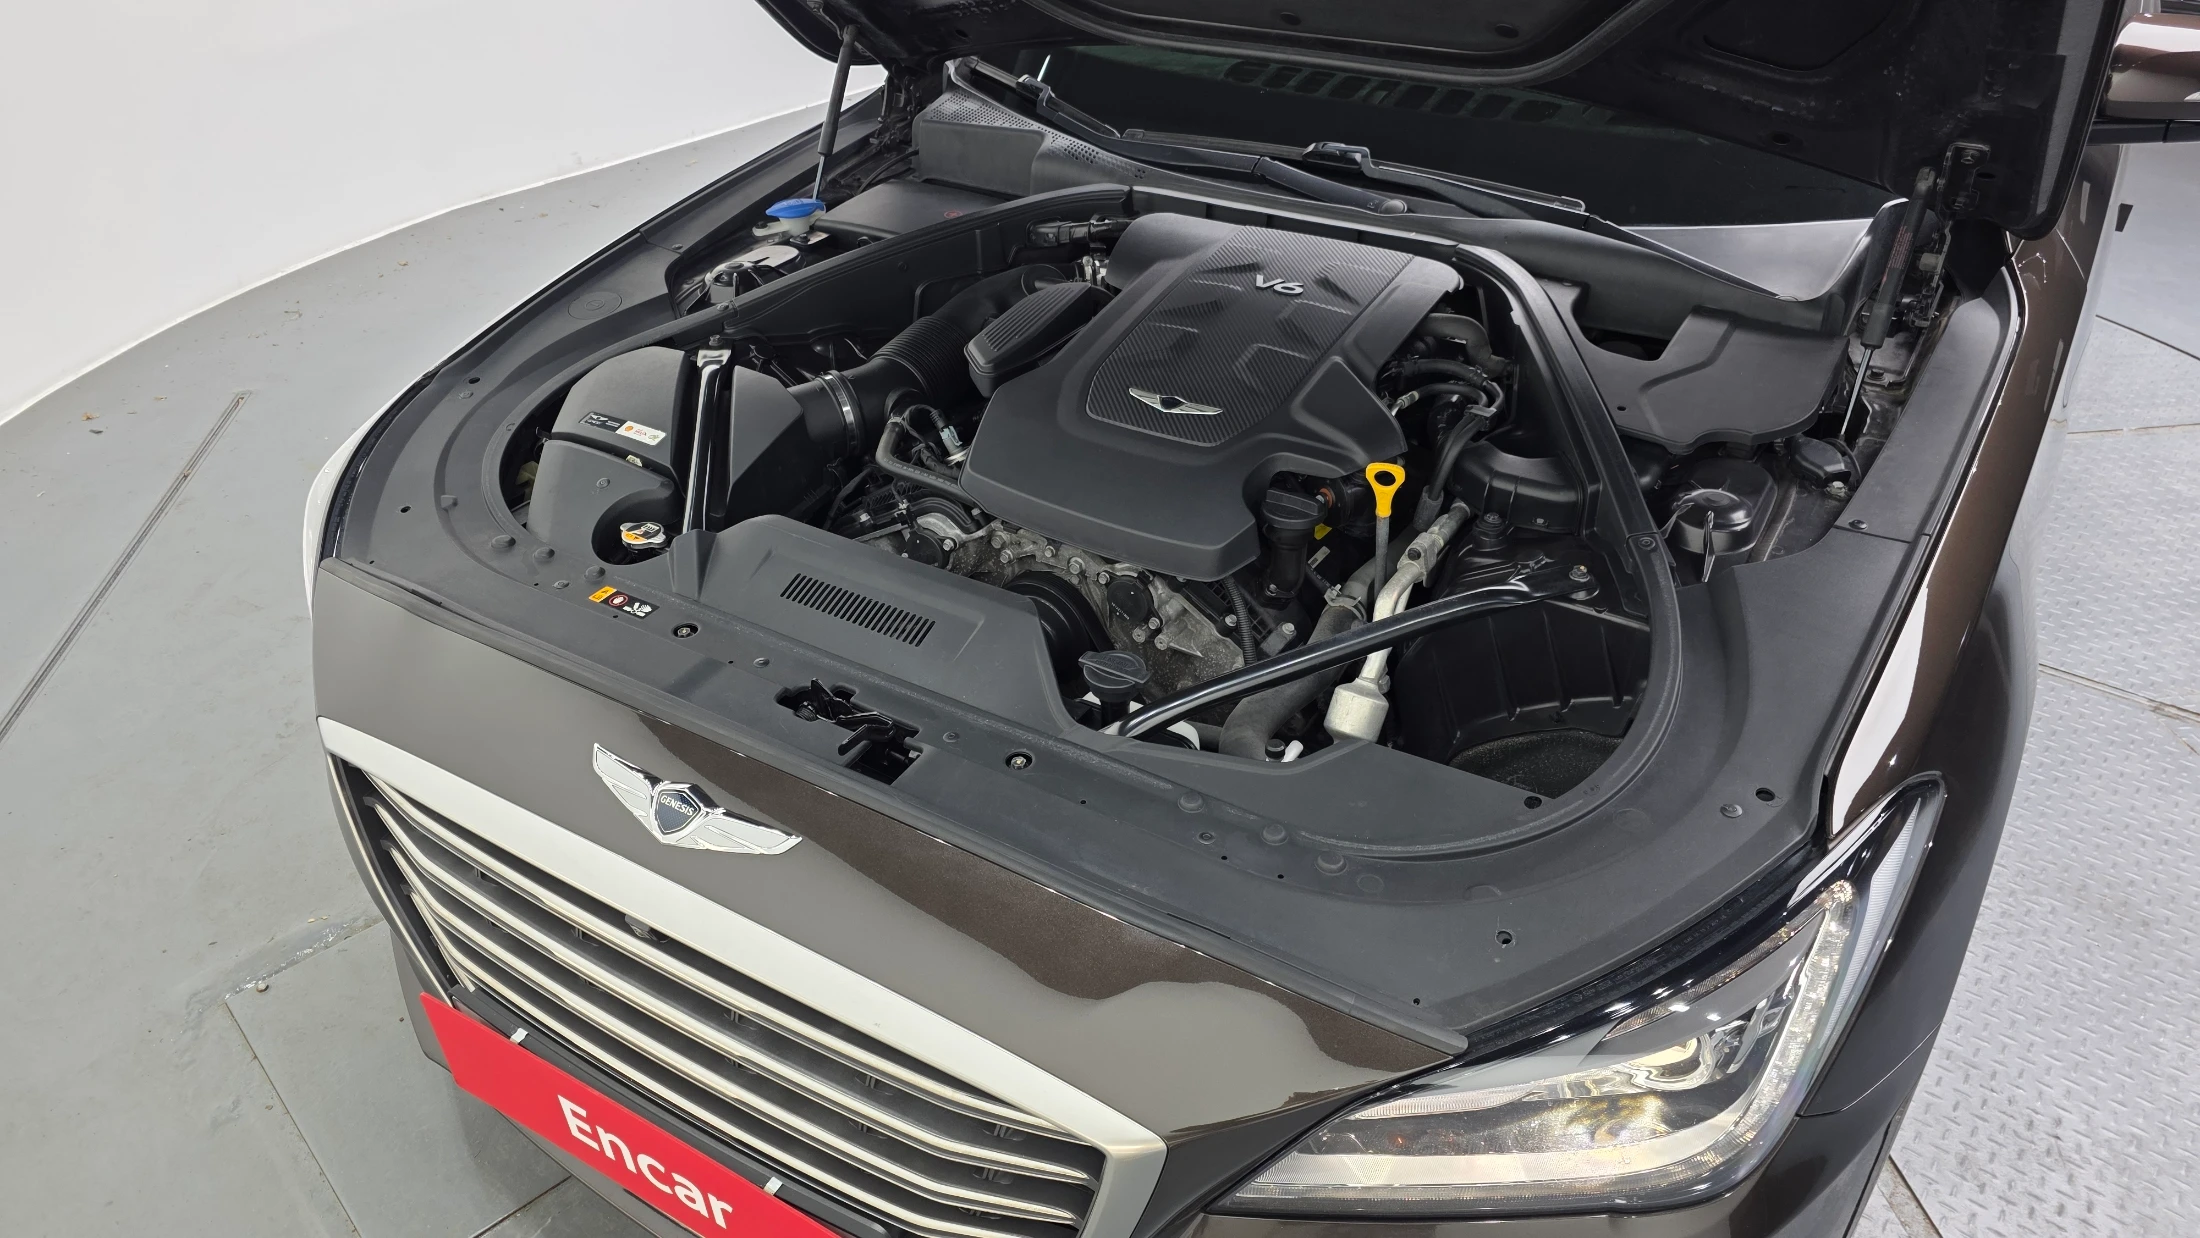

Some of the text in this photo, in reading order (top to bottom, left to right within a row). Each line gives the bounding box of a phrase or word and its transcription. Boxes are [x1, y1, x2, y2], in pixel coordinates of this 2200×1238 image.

[1256, 274, 1304, 295] V6
[660, 795, 695, 816] GENESIS
[557, 1094, 733, 1229] Encar
